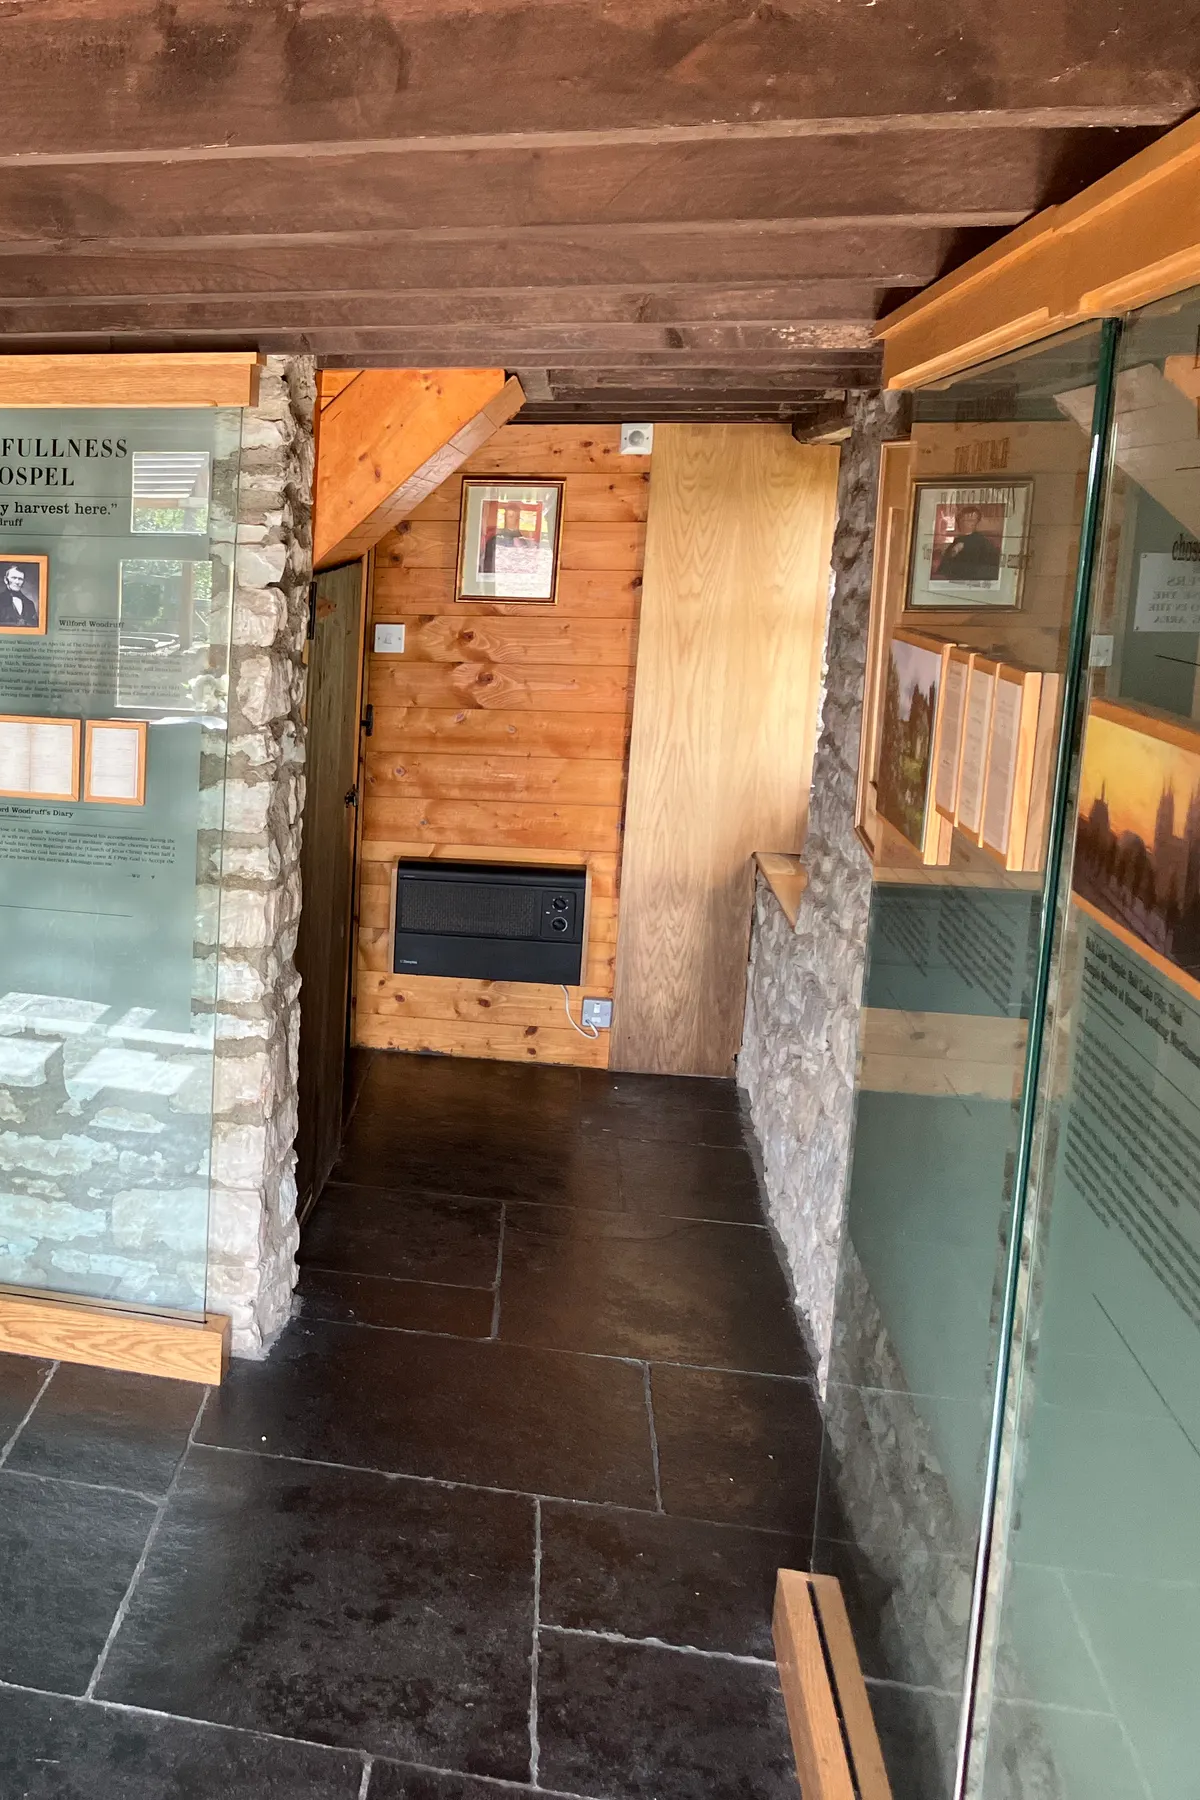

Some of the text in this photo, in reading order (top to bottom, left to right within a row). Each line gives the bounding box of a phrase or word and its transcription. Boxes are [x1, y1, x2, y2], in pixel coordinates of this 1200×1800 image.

[0, 438, 128, 458] FULLNESS
[14, 502, 69, 514] harvest
[74, 502, 118, 516] here.”
[59, 619, 124, 629] Wilford Woodruff
[12, 807, 51, 816] Woodruff’s
[53, 809, 74, 819] Diary
